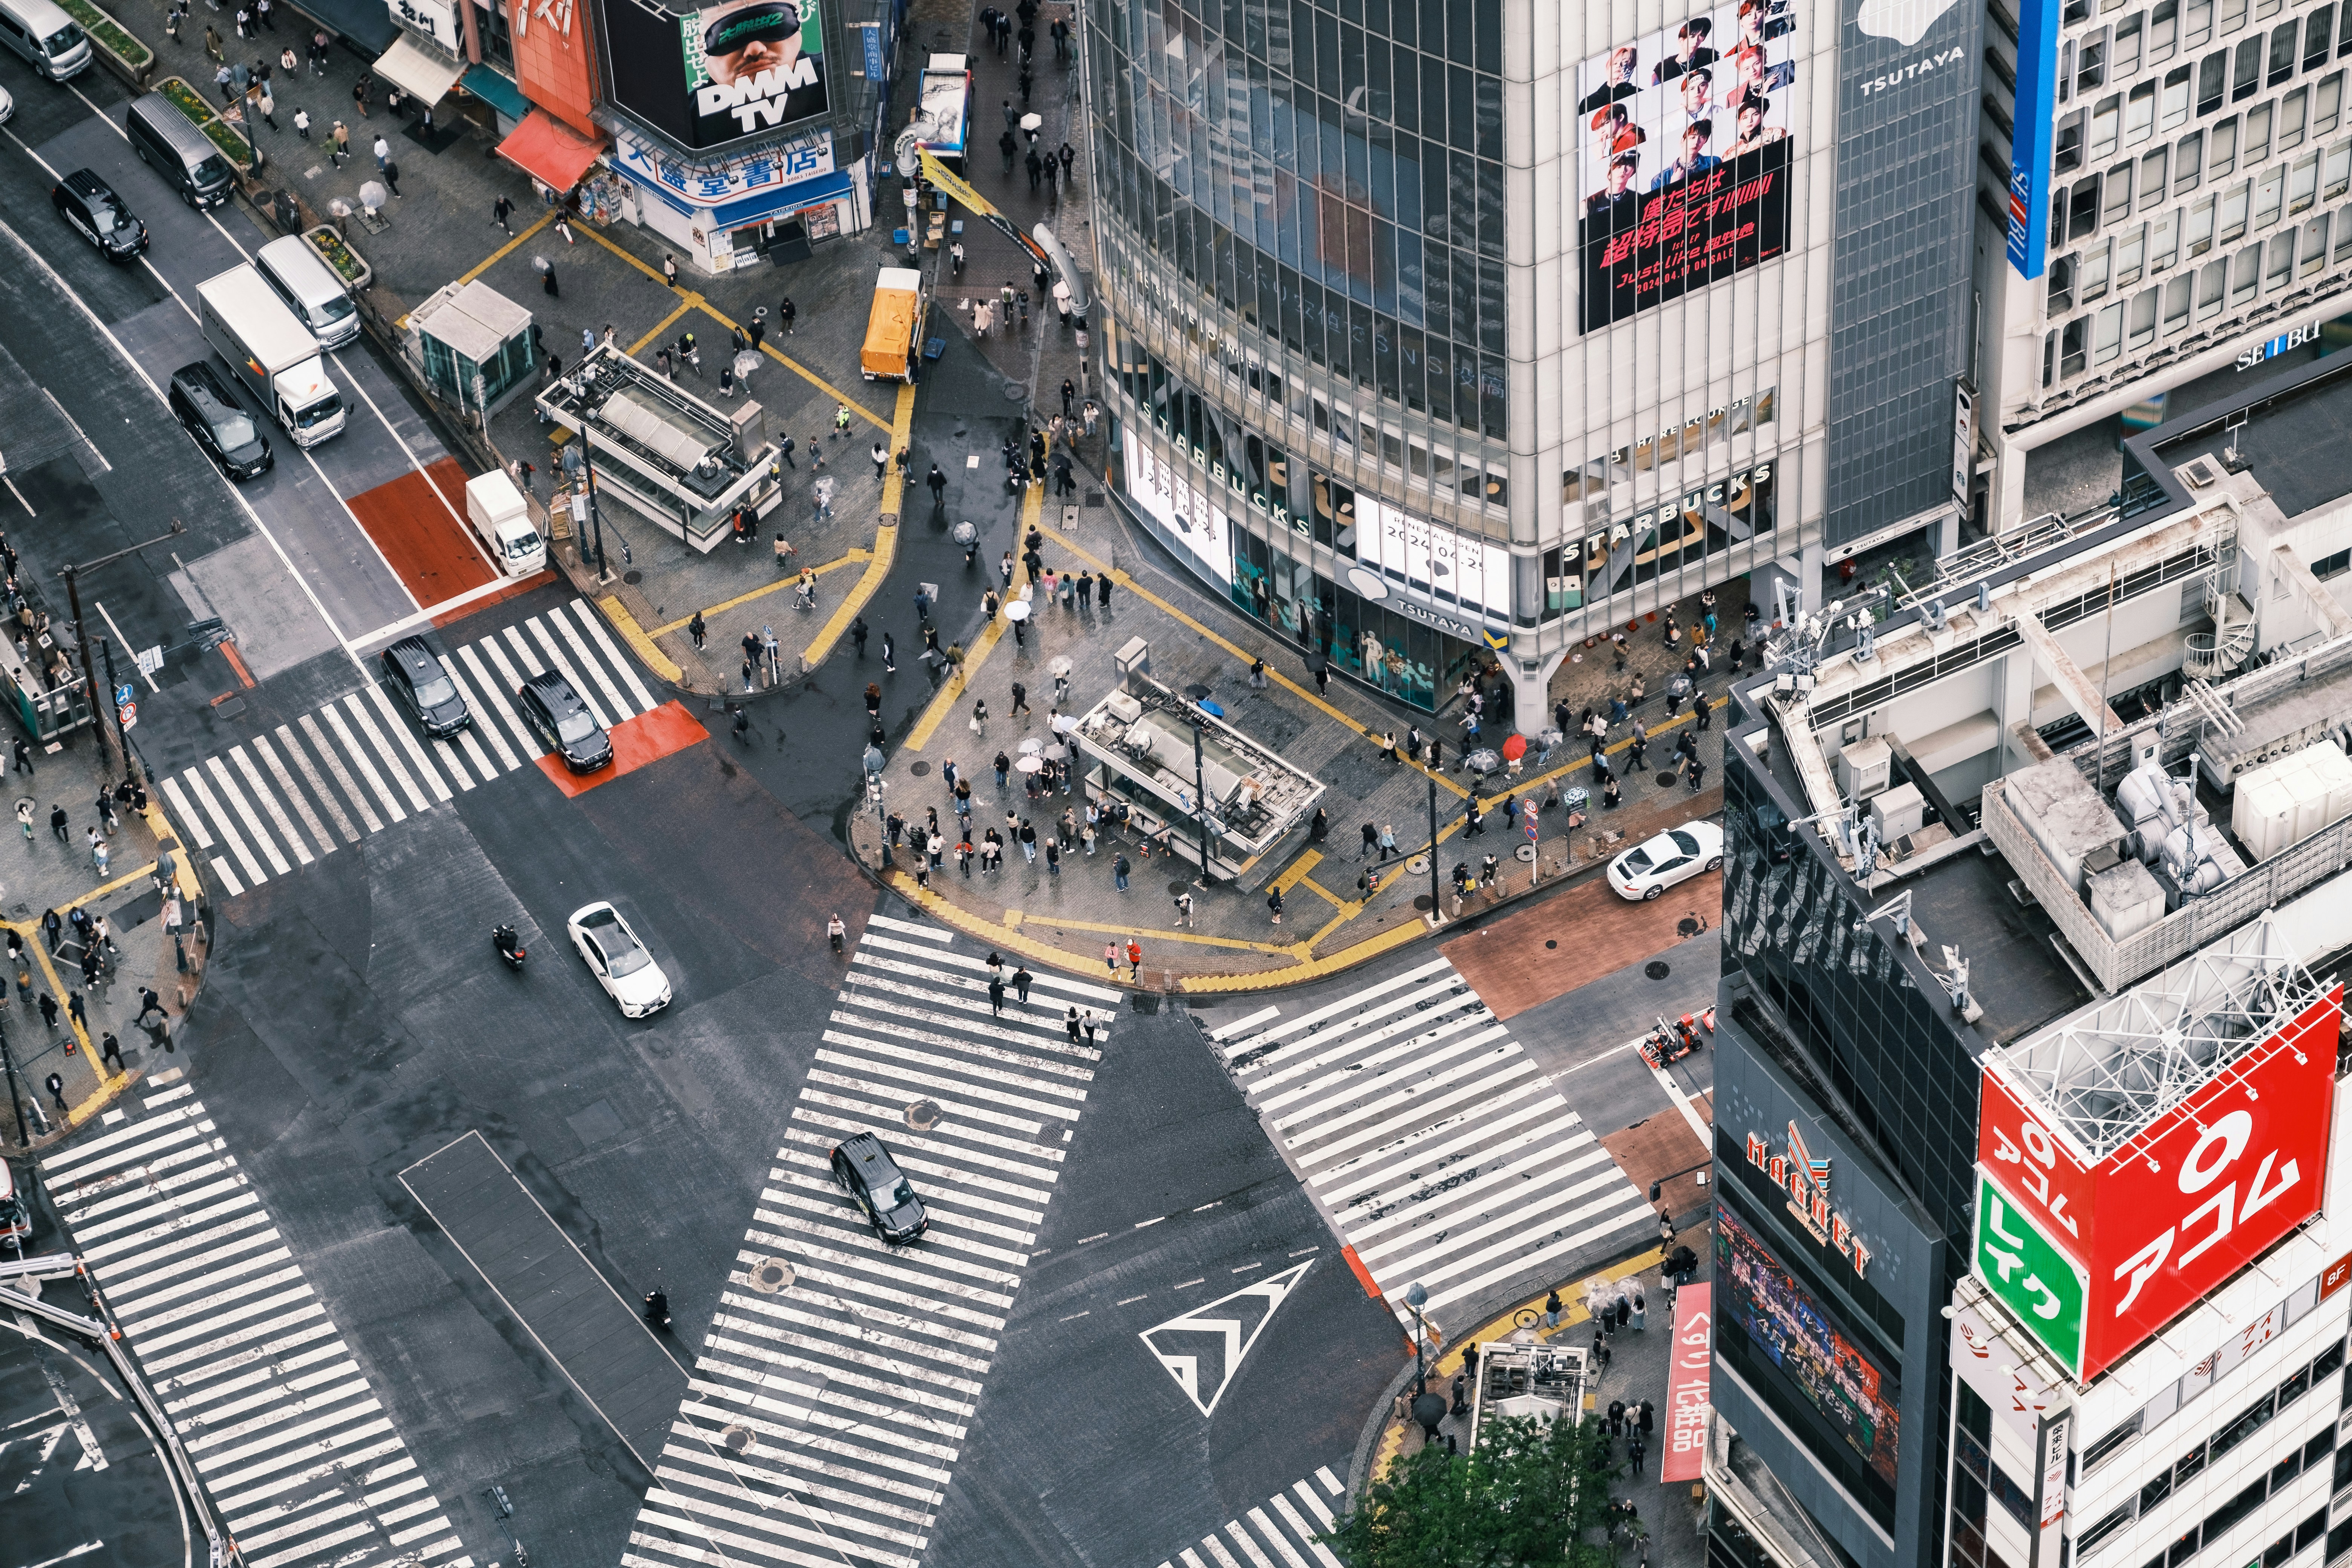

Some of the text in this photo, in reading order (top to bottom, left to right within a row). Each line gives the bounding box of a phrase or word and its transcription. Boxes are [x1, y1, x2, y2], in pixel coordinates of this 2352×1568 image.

[682, 17, 709, 88] 脱出せよ
[1860, 47, 1964, 96] TSUTAYA
[697, 57, 818, 117] DMM
[731, 93, 788, 133] TV
[805, 168, 827, 179] TAISEIDO
[1643, 168, 1726, 223] 僕たちは
[769, 203, 804, 216] TAISEIDO
[2008, 161, 2029, 261] SEIBU
[1617, 261, 1663, 289] Just
[1665, 246, 1700, 270] like
[1703, 221, 1755, 255] 超特急
[1689, 233, 1700, 245] EP
[1637, 264, 1690, 294] 2024.04.17
[1694, 261, 1707, 271] ON
[1711, 247, 1734, 265] SALE
[2237, 320, 2320, 372] SEIBU
[1142, 400, 1310, 537] STARBUCKS
[1564, 464, 1770, 562] STARBUCKS
[1857, 536, 1885, 550] TSUTAYA
[1397, 599, 1472, 637] TSUTAYA
[1746, 1130, 1871, 1280] MAGNET
[1993, 1125, 2080, 1240] アコム
[1984, 1193, 2061, 1320] レイク
[2113, 1148, 2301, 1318] アコム
[2327, 1263, 2346, 1286] 8F
[1679, 1312, 1710, 1369] くすり
[2047, 1514, 2057, 1525] 8F
